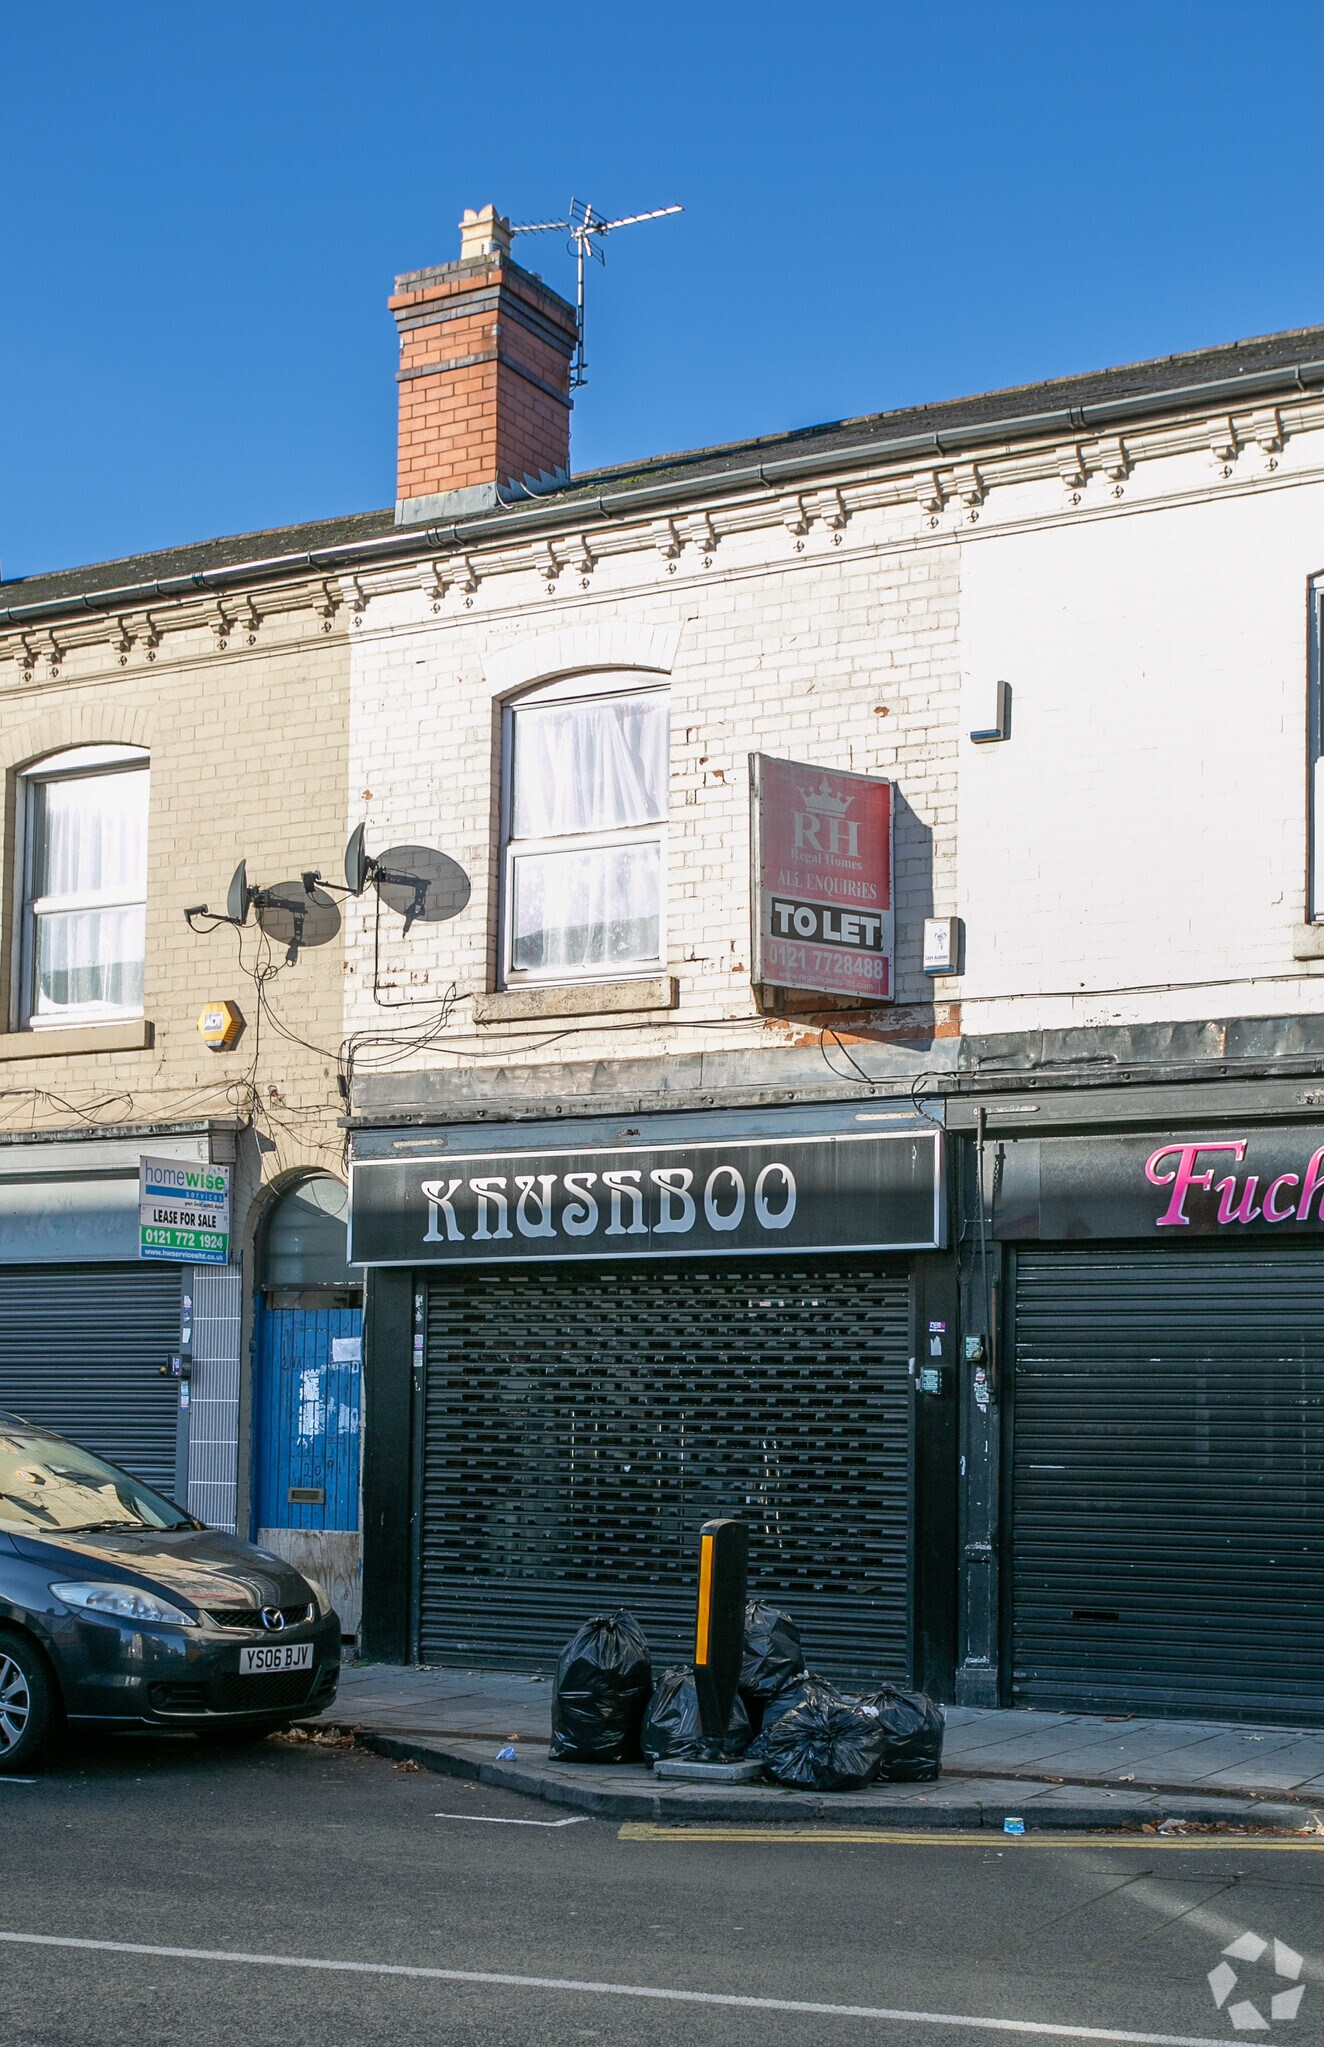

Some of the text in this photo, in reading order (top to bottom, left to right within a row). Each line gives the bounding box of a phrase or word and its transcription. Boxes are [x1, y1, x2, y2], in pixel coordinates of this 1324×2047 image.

[792, 811, 862, 858] RH
[791, 847, 863, 870] Regal Homes
[779, 868, 803, 888] ALL
[774, 902, 880, 946] TO LET
[769, 943, 883, 980] 0121 7728488
[145, 1159, 225, 1190] homewise
[185, 1191, 223, 1201] services
[153, 1209, 217, 1229] LEASE FOR SALE
[145, 1229, 223, 1249] 0121 772 1924
[144, 1249, 224, 1262] www.hwservicesltd.co.uk
[247, 1646, 308, 1670] YS06 BJV
